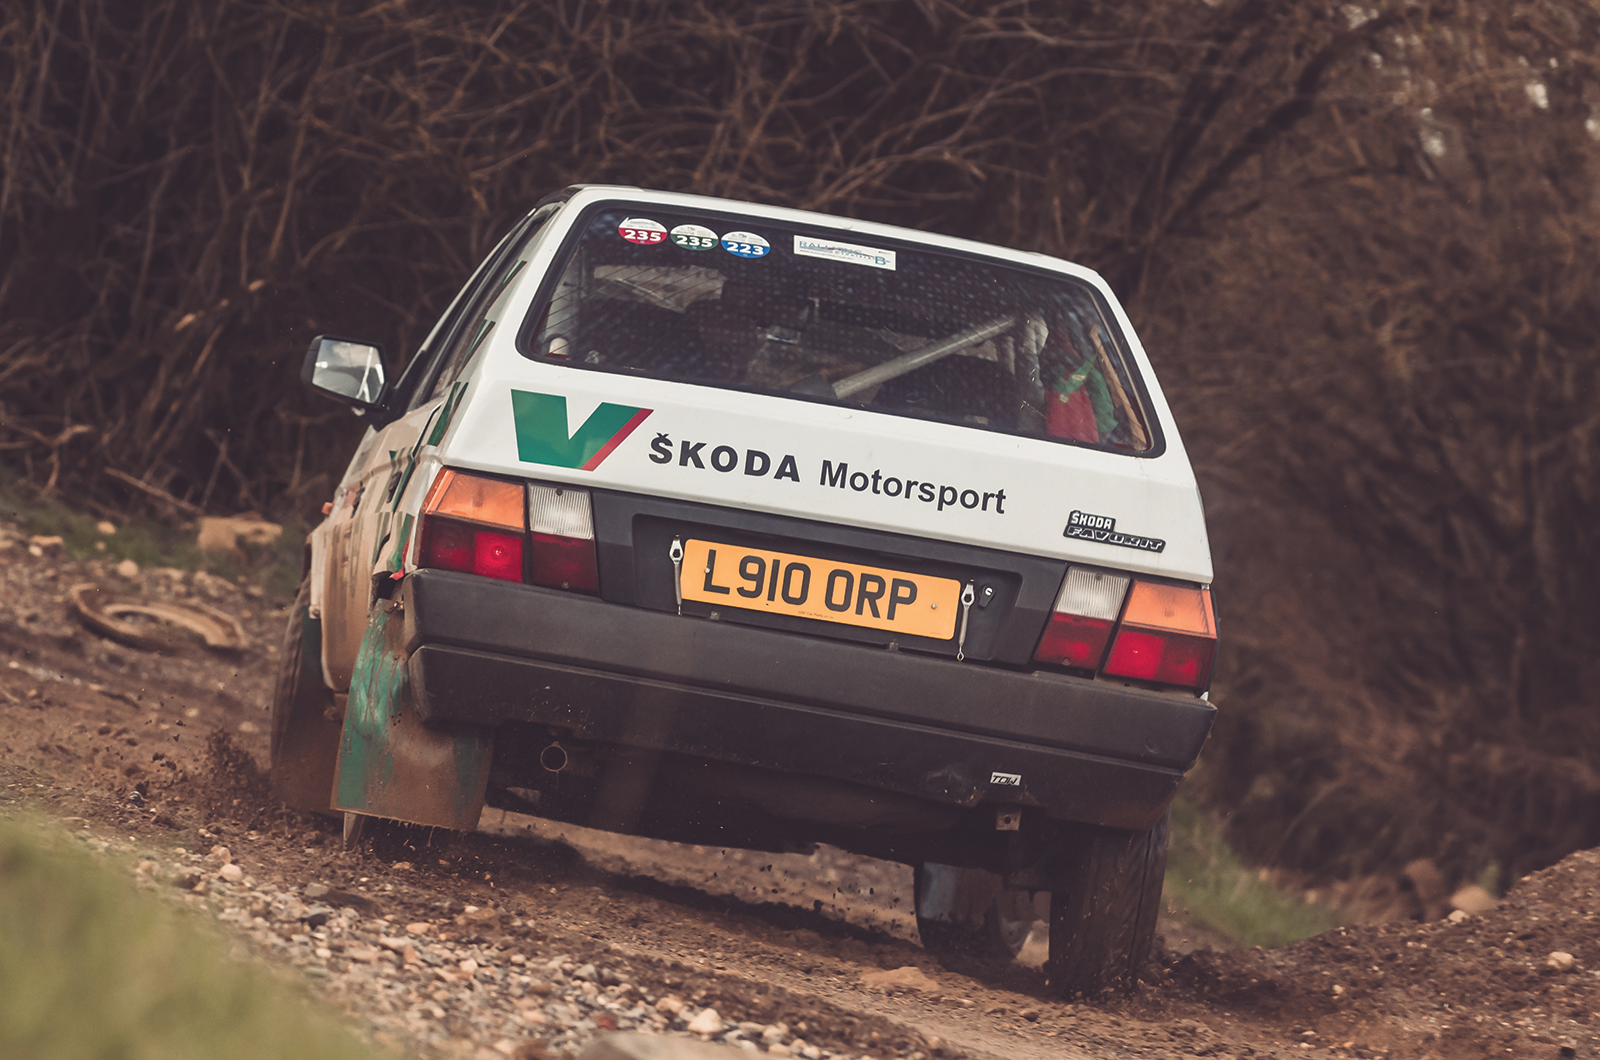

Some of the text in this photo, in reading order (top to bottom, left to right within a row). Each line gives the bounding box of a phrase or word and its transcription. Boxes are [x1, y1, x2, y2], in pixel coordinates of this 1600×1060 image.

[624, 229, 661, 242] 235
[676, 235, 713, 247] 235
[726, 241, 764, 255] 223
[648, 432, 1007, 514] ŠKODA Motorsport
[1066, 525, 1162, 550] FAVORIT
[703, 549, 918, 620] L910 ORP
[993, 775, 1018, 785] TOW
